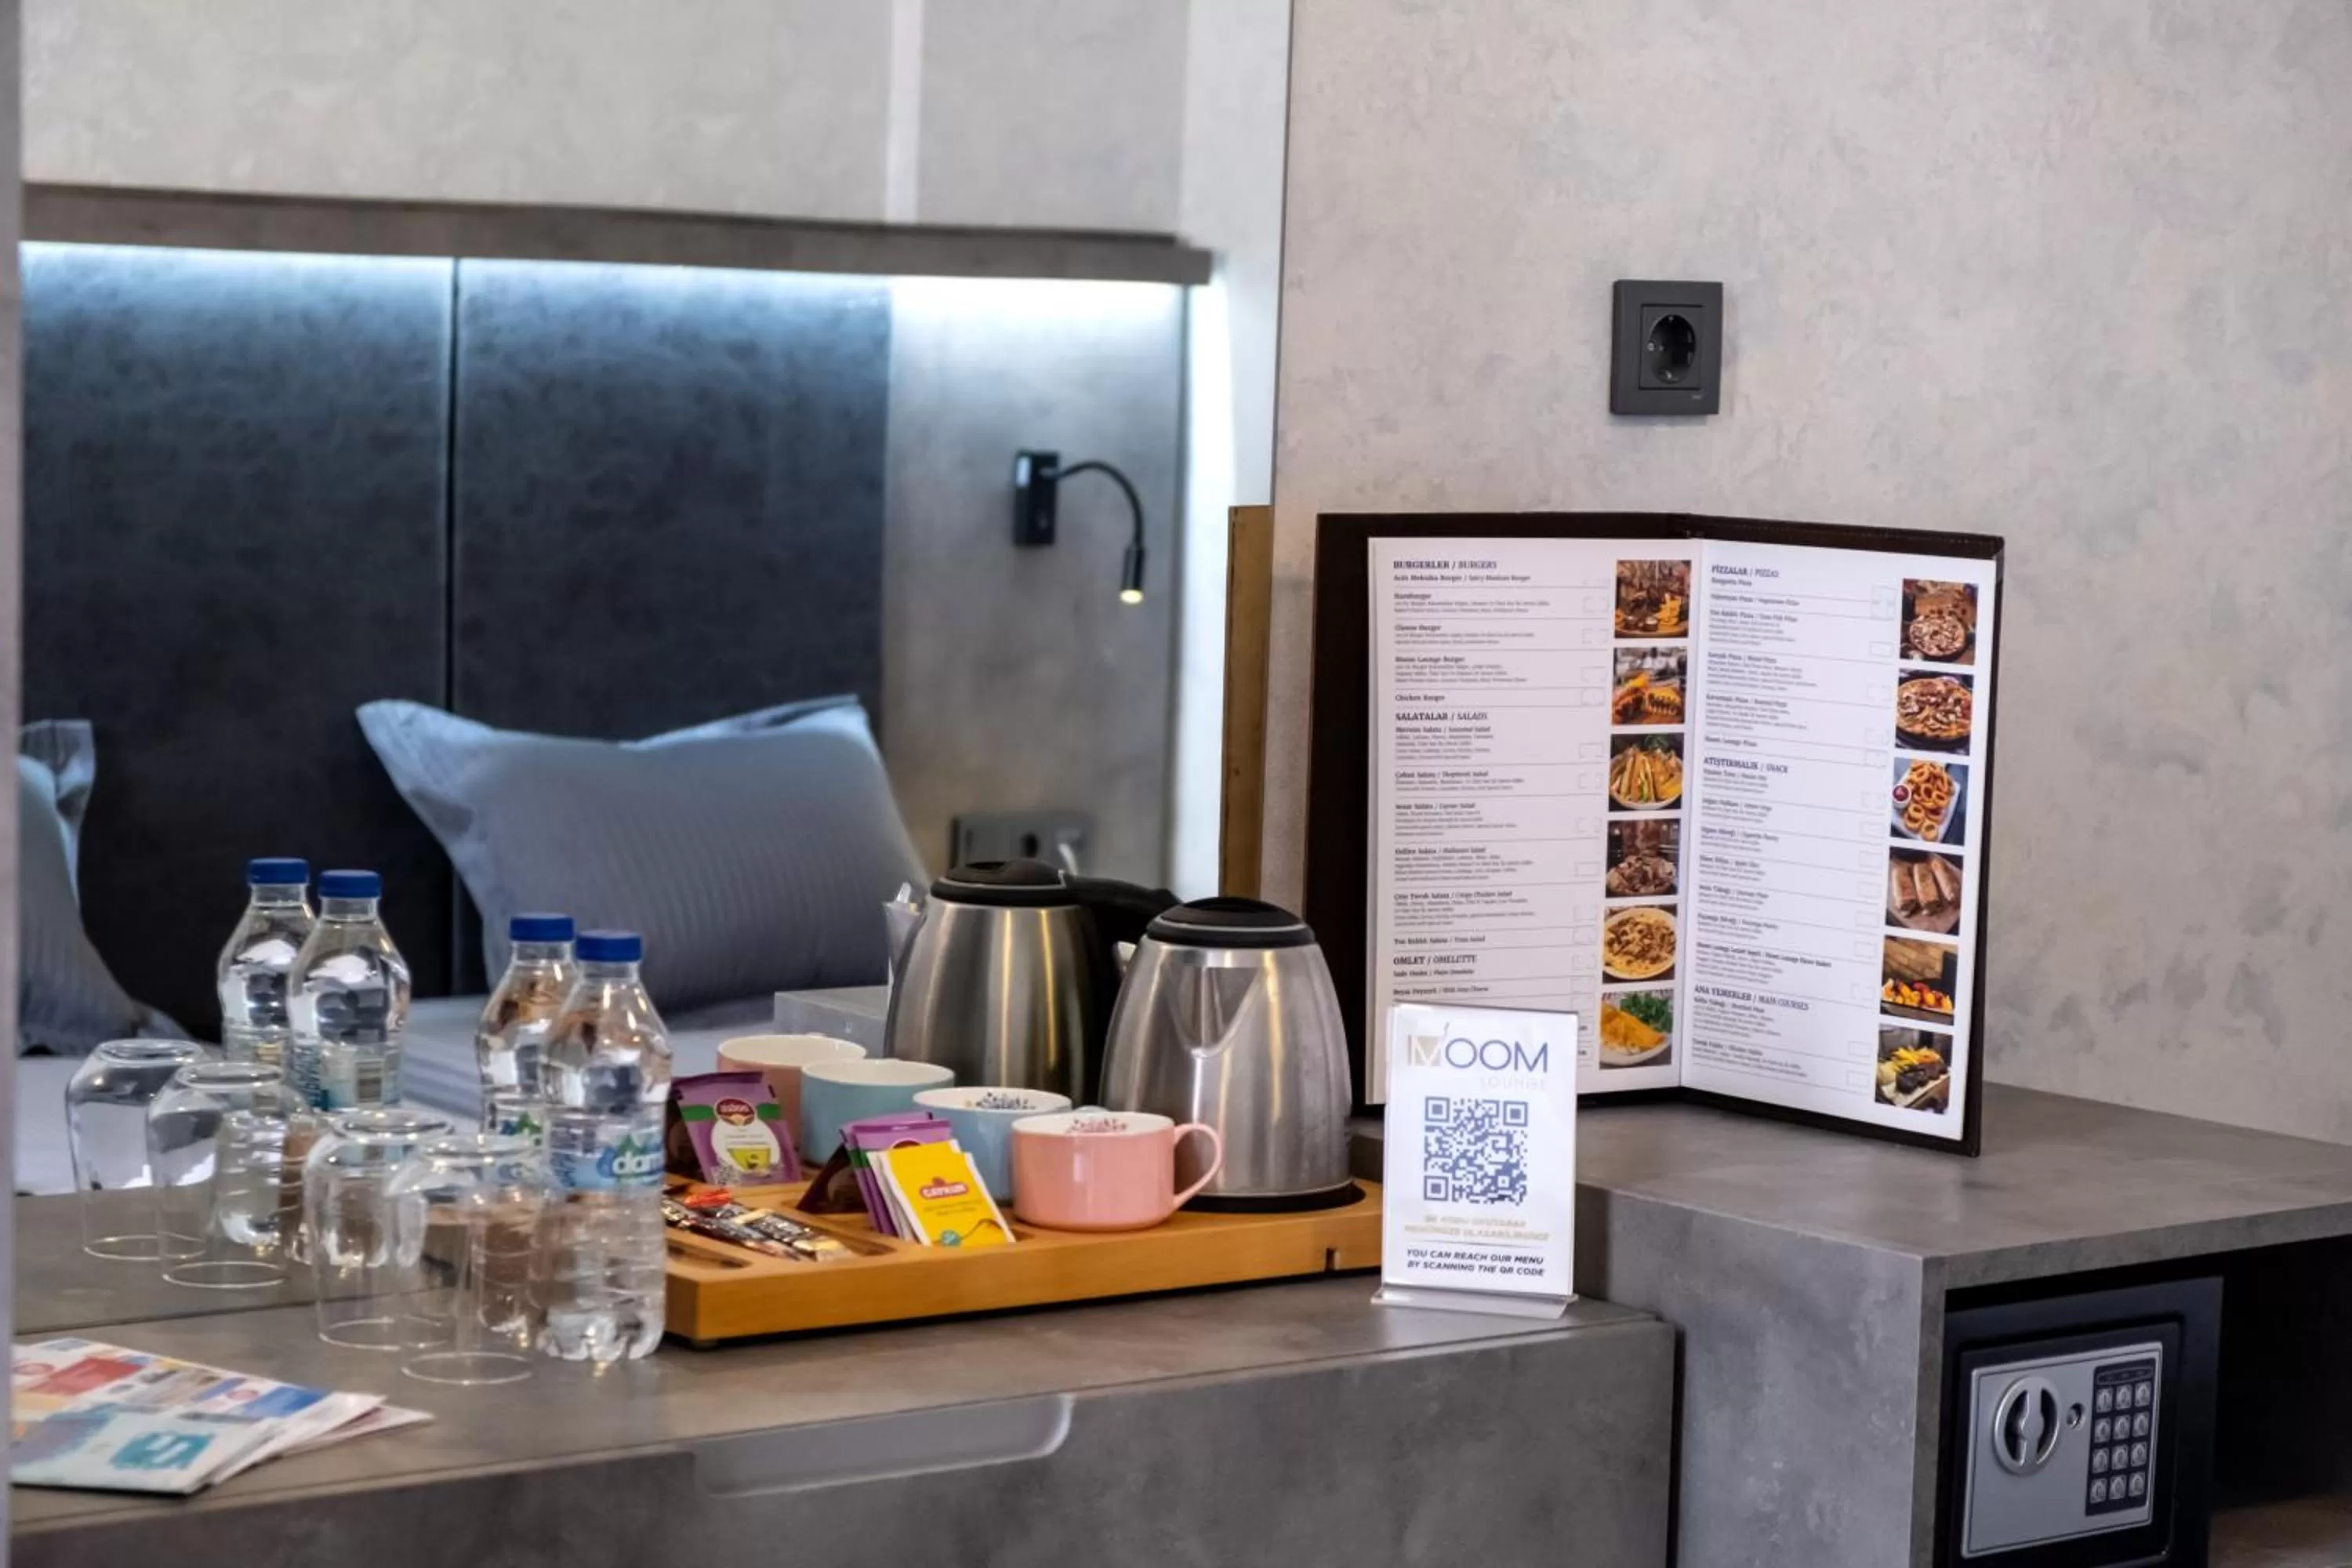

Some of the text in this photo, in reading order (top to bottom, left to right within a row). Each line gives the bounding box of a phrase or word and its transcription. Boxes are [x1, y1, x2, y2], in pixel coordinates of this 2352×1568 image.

[1394, 561, 1450, 569] BURGERLER
[1458, 561, 1497, 569] BURGERS
[1396, 712, 1448, 720] SALATALAR
[1457, 711, 1488, 720] SALADS
[1394, 956, 1425, 965] OMLET
[1407, 1249, 1544, 1265] YOU CAN REACH OUR MENU
[1423, 1261, 1475, 1272] SCANNING
[1478, 1265, 1497, 1273] THE
[1500, 1266, 1514, 1275] QR
[1516, 1268, 1545, 1277] CODE
